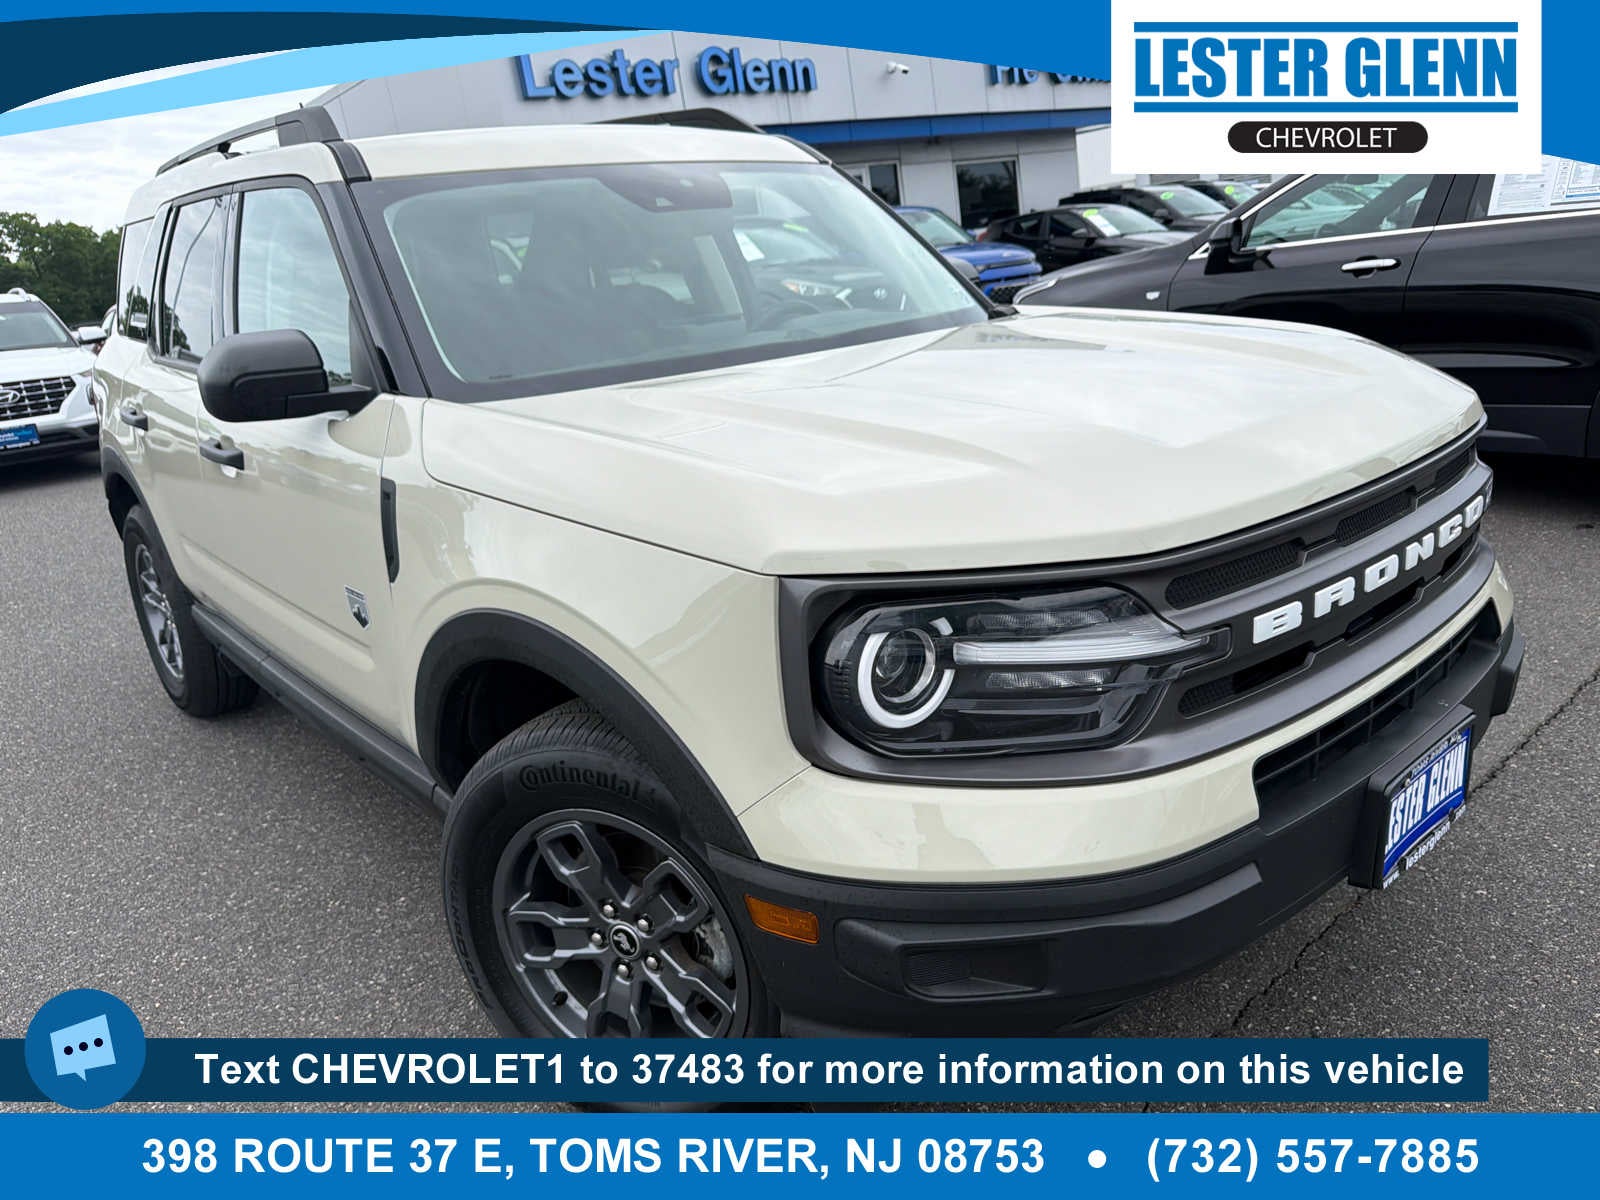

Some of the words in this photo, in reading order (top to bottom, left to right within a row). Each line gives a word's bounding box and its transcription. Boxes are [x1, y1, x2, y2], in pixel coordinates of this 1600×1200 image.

[514, 48, 680, 100] Lester
[697, 45, 819, 97] Glenn
[1252, 494, 1486, 645] BRONCO
[519, 759, 641, 801] Continental
[1427, 740, 1467, 813] GLENN
